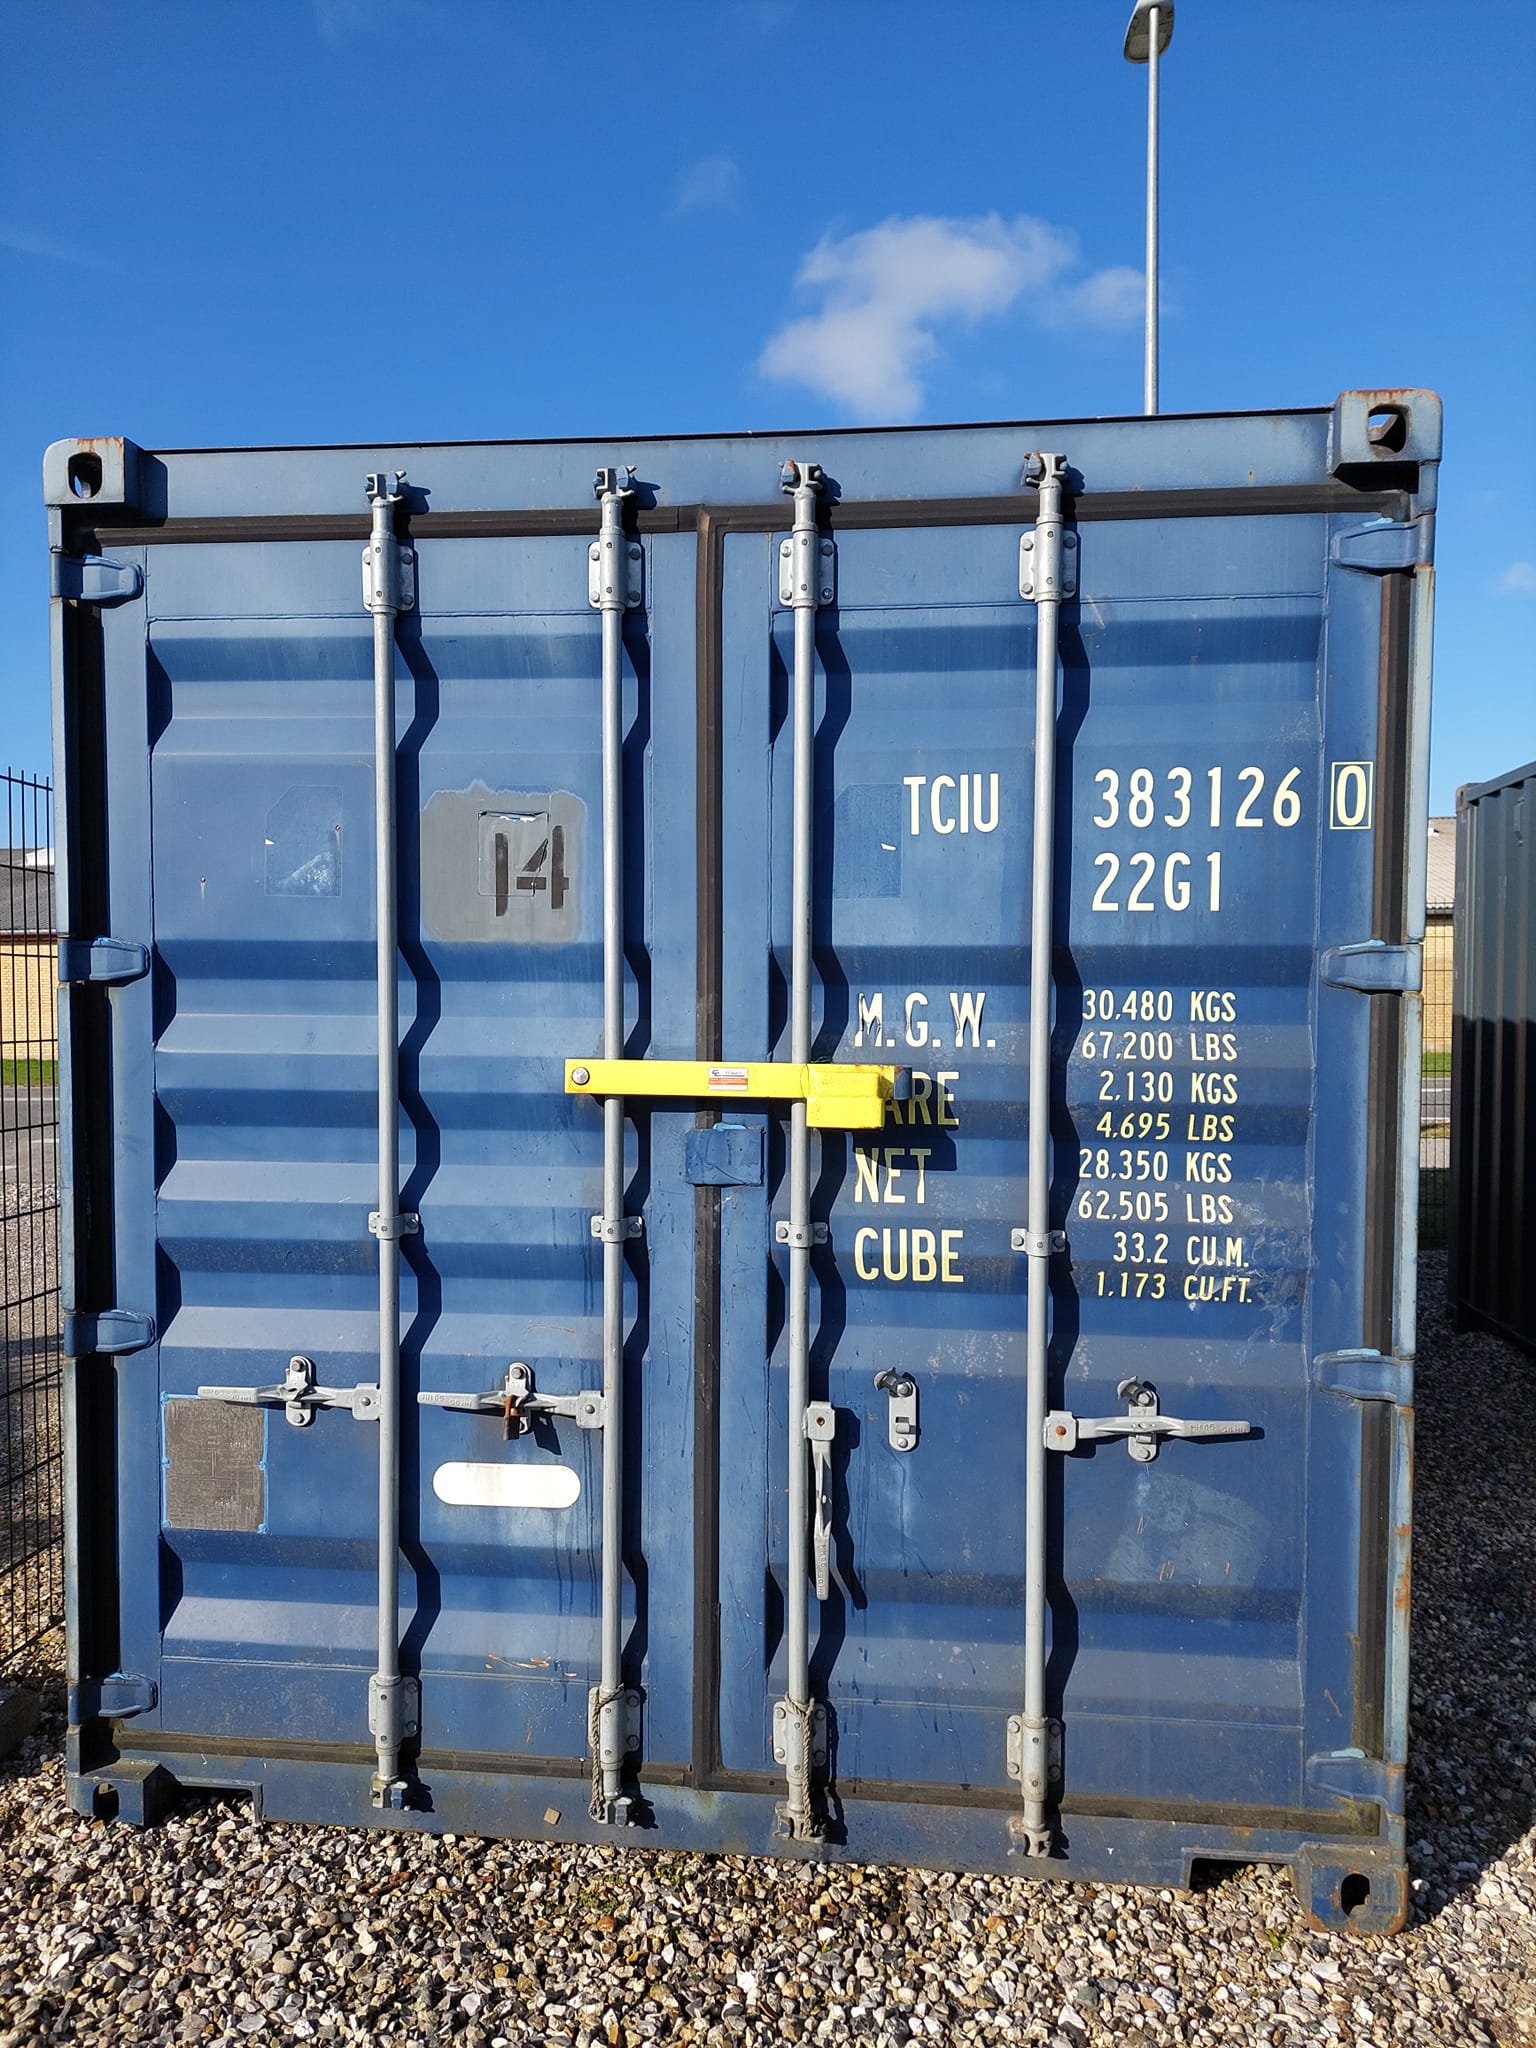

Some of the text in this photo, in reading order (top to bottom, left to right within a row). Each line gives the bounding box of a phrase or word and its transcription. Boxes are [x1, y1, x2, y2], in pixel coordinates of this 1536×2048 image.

[904, 765, 1367, 835] TCIU 383126 0
[495, 825, 569, 916] 14
[1092, 852, 1221, 912] 22G1
[1082, 989, 1173, 1022] 30,480
[1190, 991, 1236, 1022] KGS
[1081, 1032, 1237, 1062] 67,200 LBS
[1099, 1070, 1173, 1103] 2,130
[1191, 1072, 1237, 1104] KGS
[1096, 1111, 1235, 1142] 4,695 LBS
[854, 1148, 1232, 1204] NET 28,350 KGS
[1078, 1190, 1233, 1224] 62,505 LBS
[854, 1227, 965, 1283] CUBE
[1113, 1231, 1169, 1264] 33.2
[1097, 1271, 1166, 1299] 1,173
